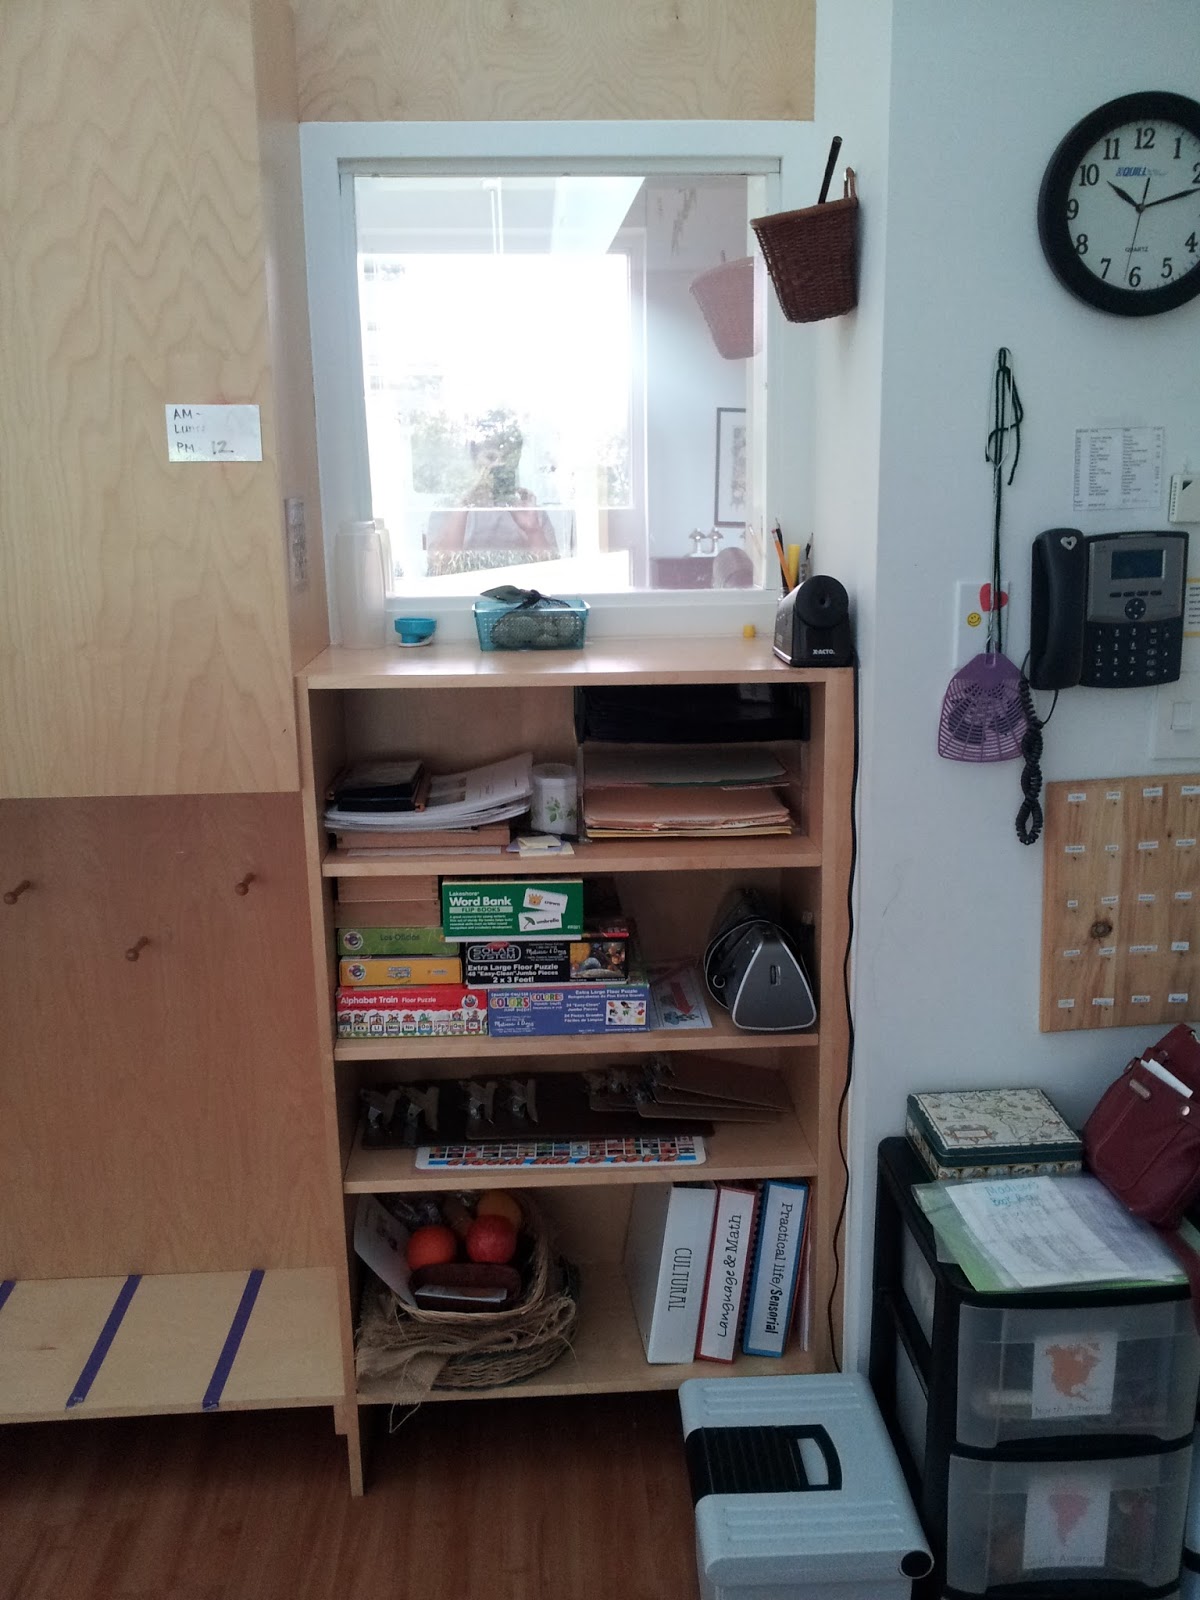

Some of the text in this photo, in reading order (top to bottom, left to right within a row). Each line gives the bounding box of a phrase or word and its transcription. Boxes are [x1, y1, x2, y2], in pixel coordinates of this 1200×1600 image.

[1103, 138, 1121, 160] 11
[1134, 127, 1156, 149] 12
[1173, 137, 1182, 159] 1
[1078, 164, 1100, 186] 10
[1067, 199, 1080, 221] 9
[1075, 233, 1089, 255] 8
[1185, 232, 1198, 253] 4
[1100, 258, 1112, 279] 7
[1128, 266, 1142, 288] 6
[1161, 257, 1173, 279] 5
[449, 896, 512, 907] Word Bank
[490, 964, 512, 972] Large
[513, 963, 533, 971] Floor
[341, 996, 377, 1005] Alphabet
[379, 995, 399, 1004] Train
[490, 996, 530, 1009] COLORS
[531, 992, 564, 1002] COLORES
[774, 1201, 793, 1262] Practical
[667, 1247, 693, 1313] CULTURAL
[717, 1214, 742, 1338] Language & Math
